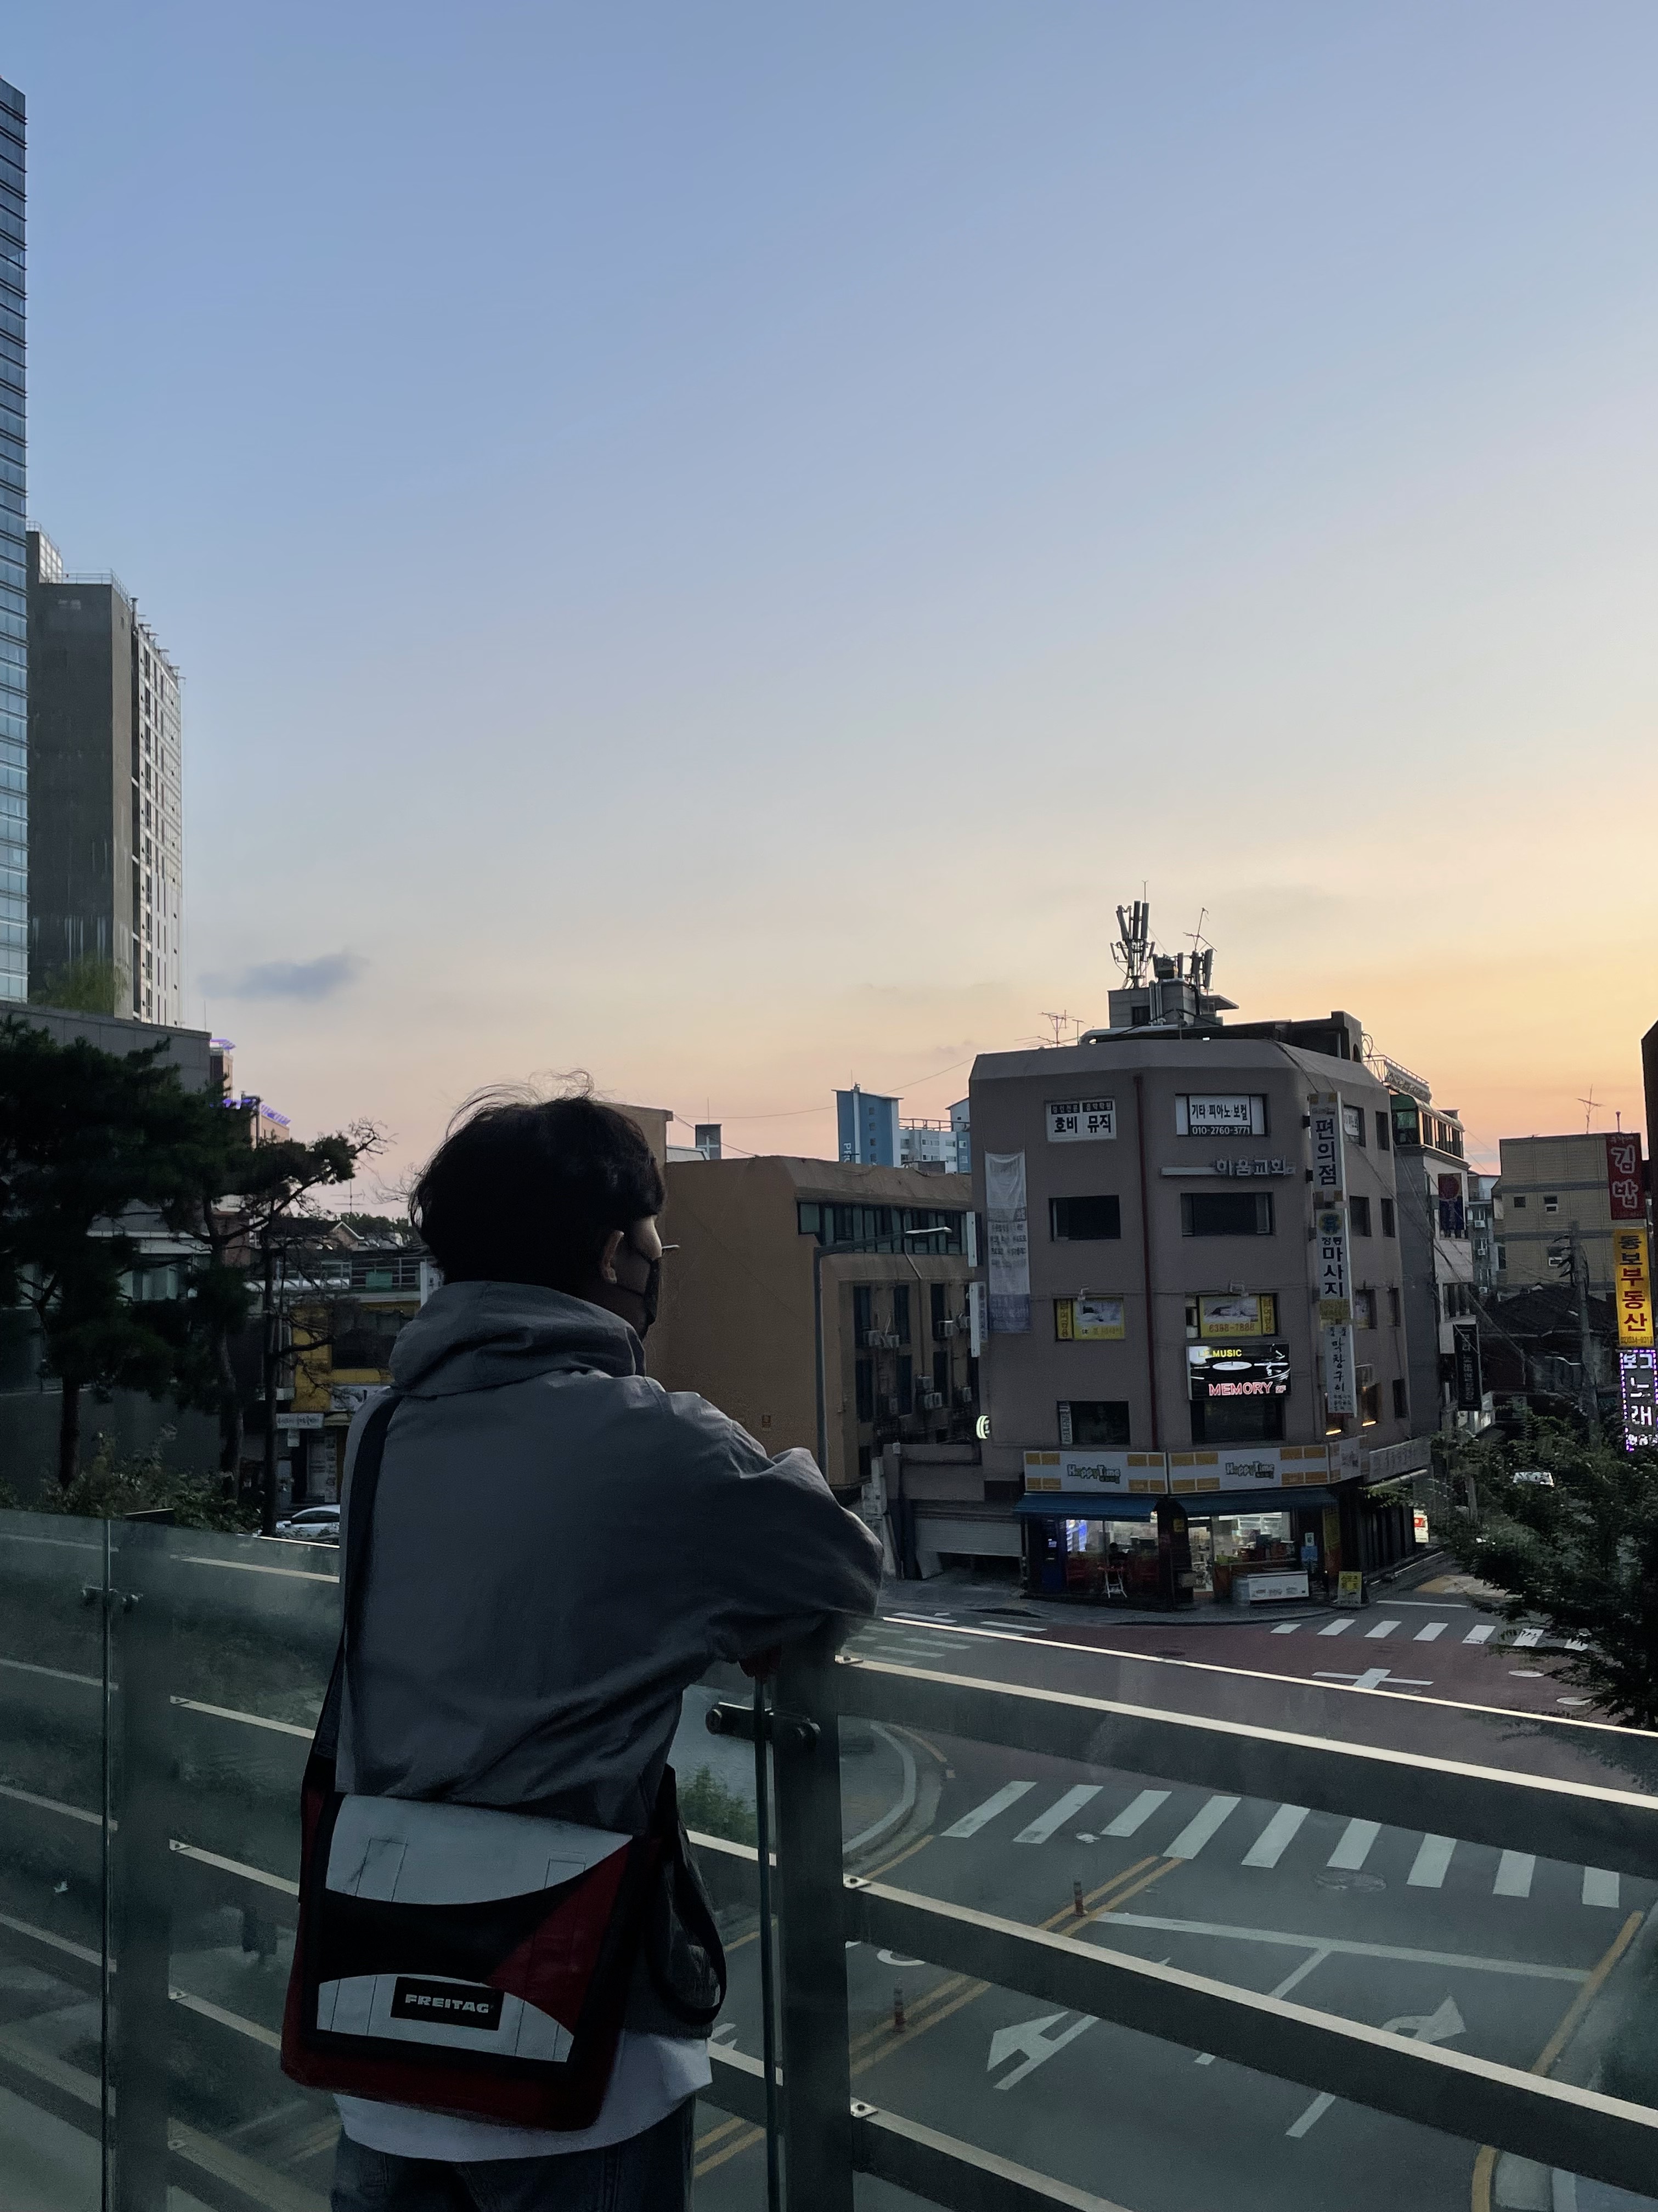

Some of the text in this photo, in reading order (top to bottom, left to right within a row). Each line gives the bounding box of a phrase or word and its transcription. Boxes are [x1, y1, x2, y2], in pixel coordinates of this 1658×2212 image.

[1054, 1114, 1111, 1133] 호비 뮤직
[1192, 1126, 1250, 1135] 010-2760-3771
[1316, 1118, 1336, 1186] 편의점
[1611, 1144, 1639, 1209] 김밥
[1323, 1247, 1344, 1298] 마사지
[1213, 1350, 1242, 1358] MUSIC
[1209, 1381, 1273, 1396] MEMORY
[405, 1994, 489, 2013] FREITAG
